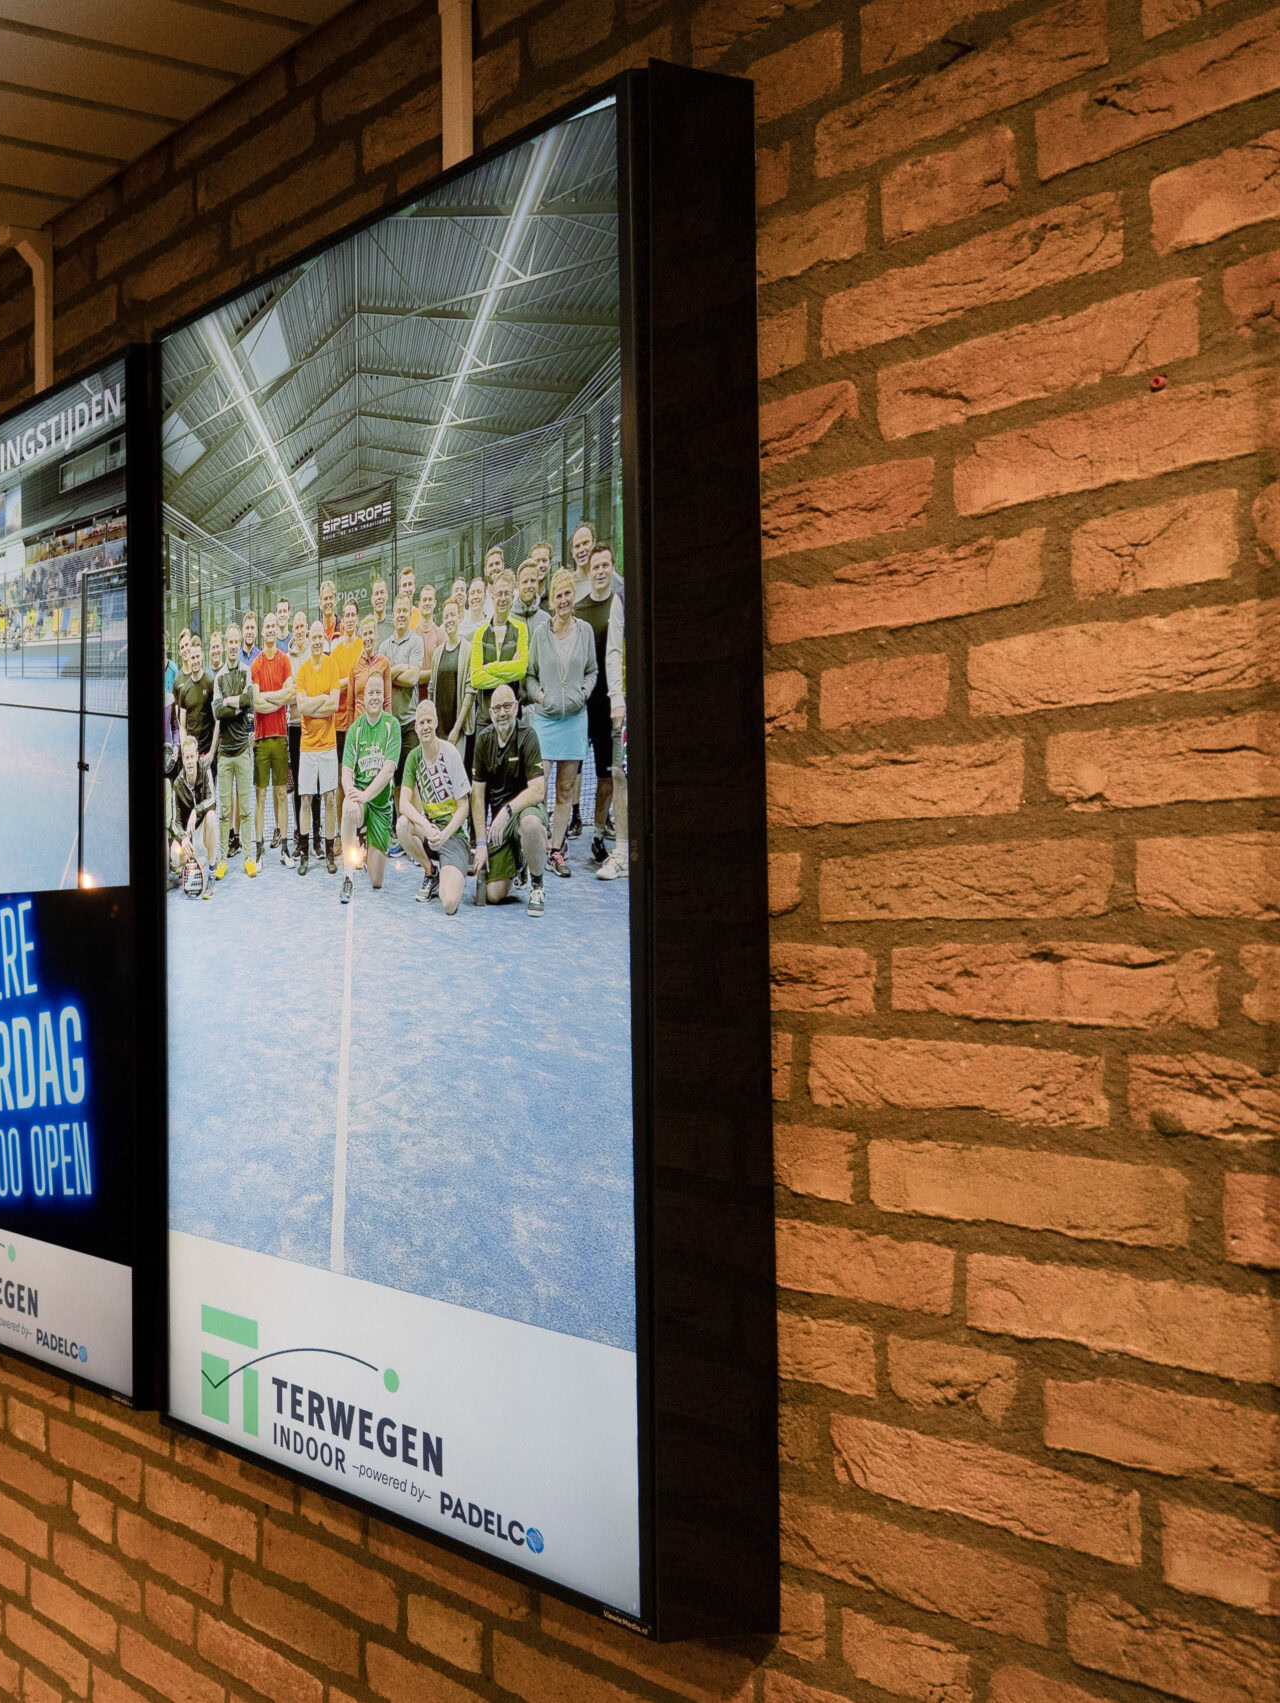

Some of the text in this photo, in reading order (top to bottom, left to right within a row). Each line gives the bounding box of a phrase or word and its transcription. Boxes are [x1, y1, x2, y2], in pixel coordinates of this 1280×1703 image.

[30, 1121, 92, 1197] OPEN
[36, 1328, 88, 1363] PADELCO
[271, 1376, 444, 1477] TERWEGEN
[273, 1422, 346, 1474] INDOOR
[440, 1491, 545, 1554] PADELCO
